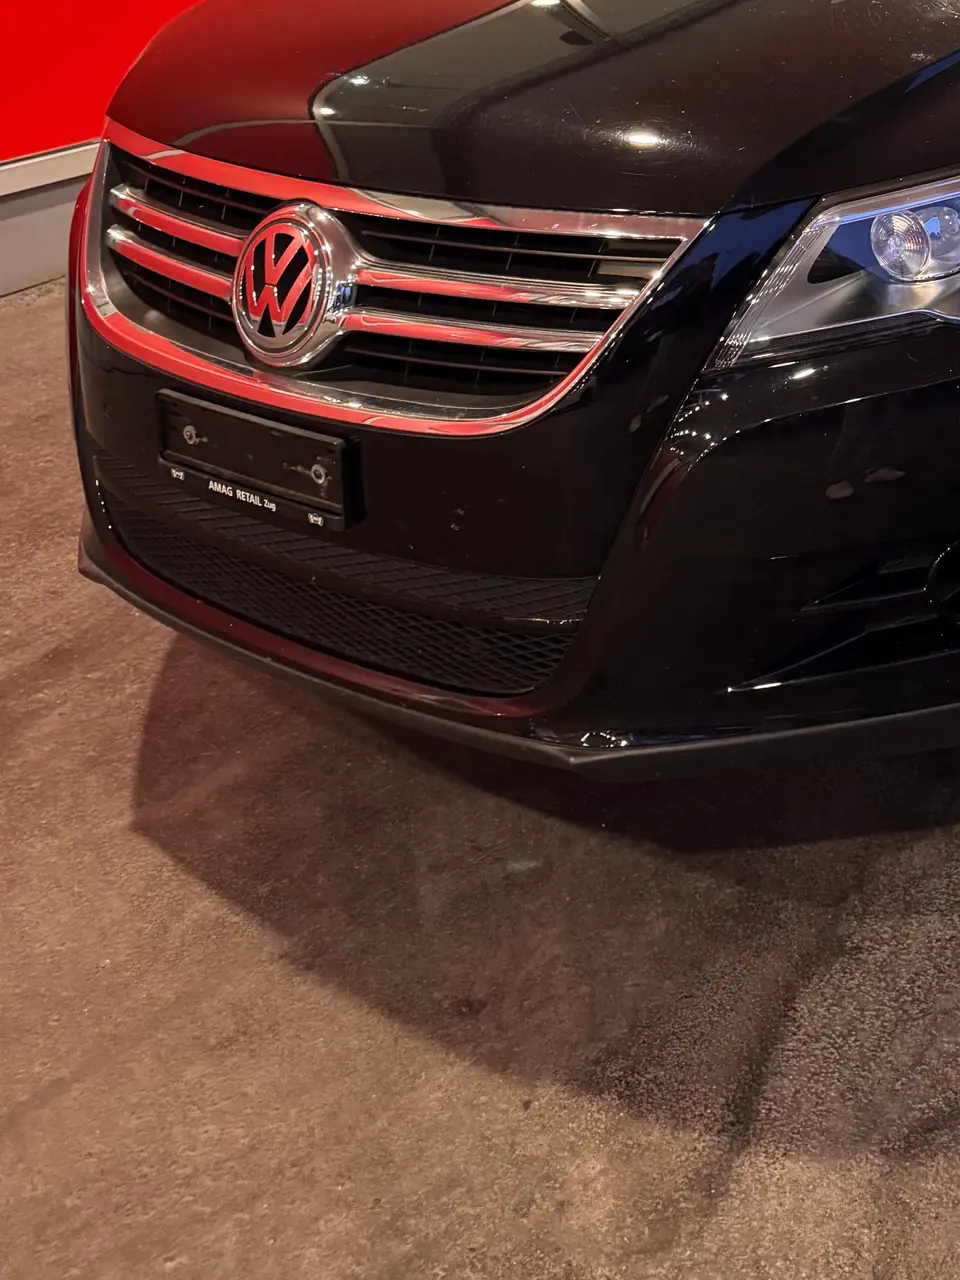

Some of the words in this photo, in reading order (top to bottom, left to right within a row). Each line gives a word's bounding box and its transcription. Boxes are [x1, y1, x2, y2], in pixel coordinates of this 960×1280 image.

[238, 220, 322, 347] VW
[208, 480, 233, 497] AMAG
[236, 489, 262, 507] RETAIL
[263, 499, 276, 512] Zug
